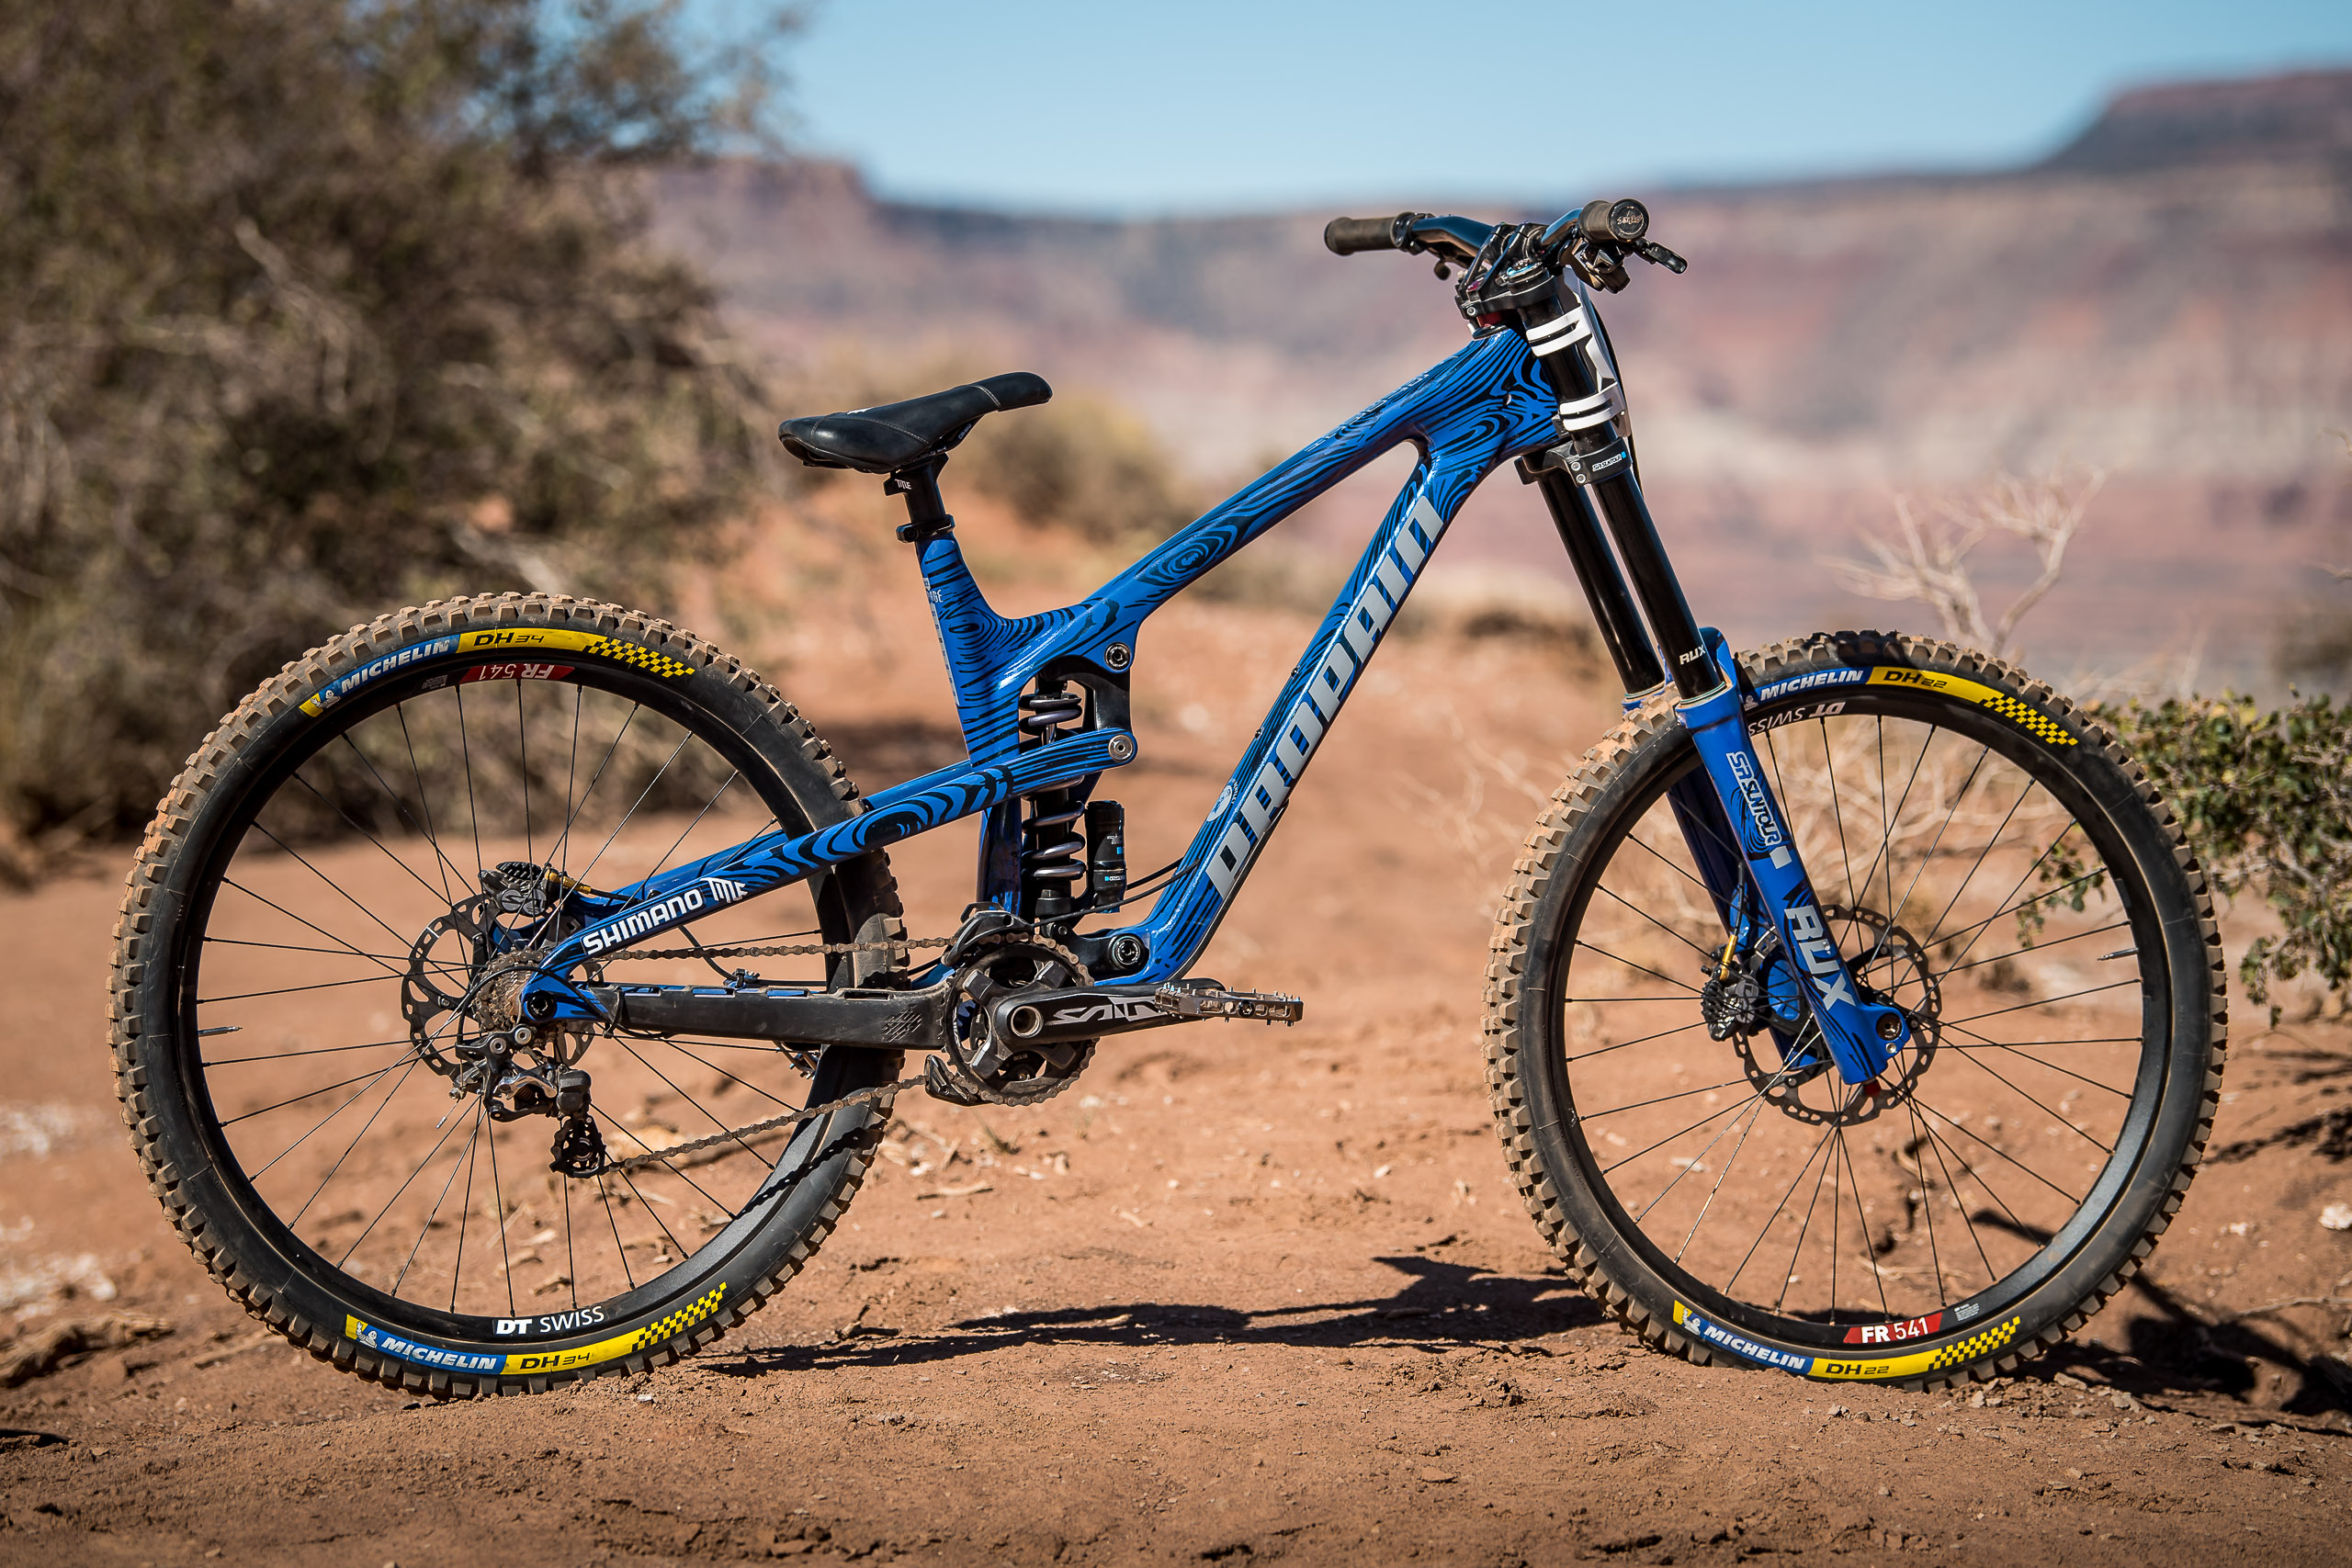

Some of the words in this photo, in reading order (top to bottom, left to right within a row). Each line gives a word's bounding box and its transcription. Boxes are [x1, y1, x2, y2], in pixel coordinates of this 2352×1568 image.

[895, 479, 912, 490] TITLE
[341, 638, 450, 694] MICHELIN
[1679, 644, 1706, 665] RUX
[479, 663, 517, 681] 541
[522, 664, 555, 679] FR
[1760, 669, 1864, 702] MICHELIN
[1206, 495, 1443, 899] PROPAIN
[1808, 701, 1846, 718] DT
[1747, 707, 1805, 736] SWISS
[1726, 751, 1754, 781] SR
[1741, 778, 1781, 846] SUNTOUR
[582, 888, 704, 955] SHIMANO
[1784, 905, 1856, 1011] RUX
[496, 1319, 532, 1335] DT
[539, 1306, 605, 1333] SWISS
[1860, 1326, 1889, 1344] FR
[1895, 1316, 1929, 1340] 541
[381, 1337, 497, 1371] MICHELIN
[1704, 1325, 1806, 1370] MICHELIN
